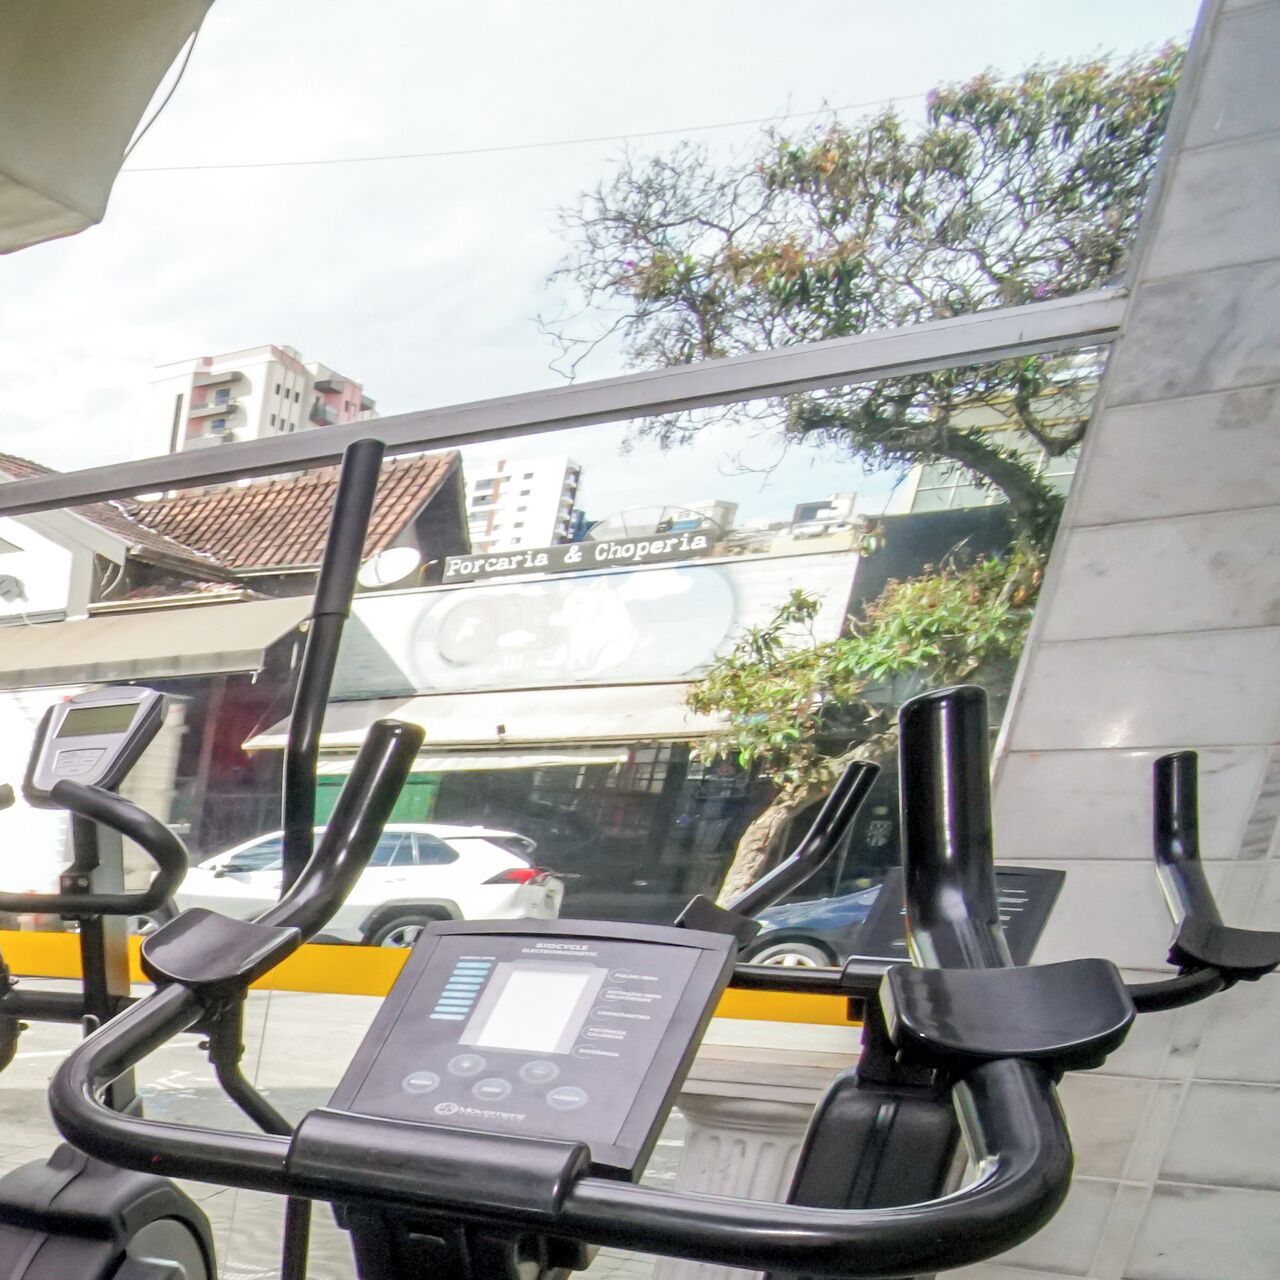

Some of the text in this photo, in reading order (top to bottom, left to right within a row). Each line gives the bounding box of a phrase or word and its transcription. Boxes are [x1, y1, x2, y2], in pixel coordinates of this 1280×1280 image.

[446, 533, 708, 576] Porcaria & Choperia
[536, 942, 589, 951] BIOCYCLE
